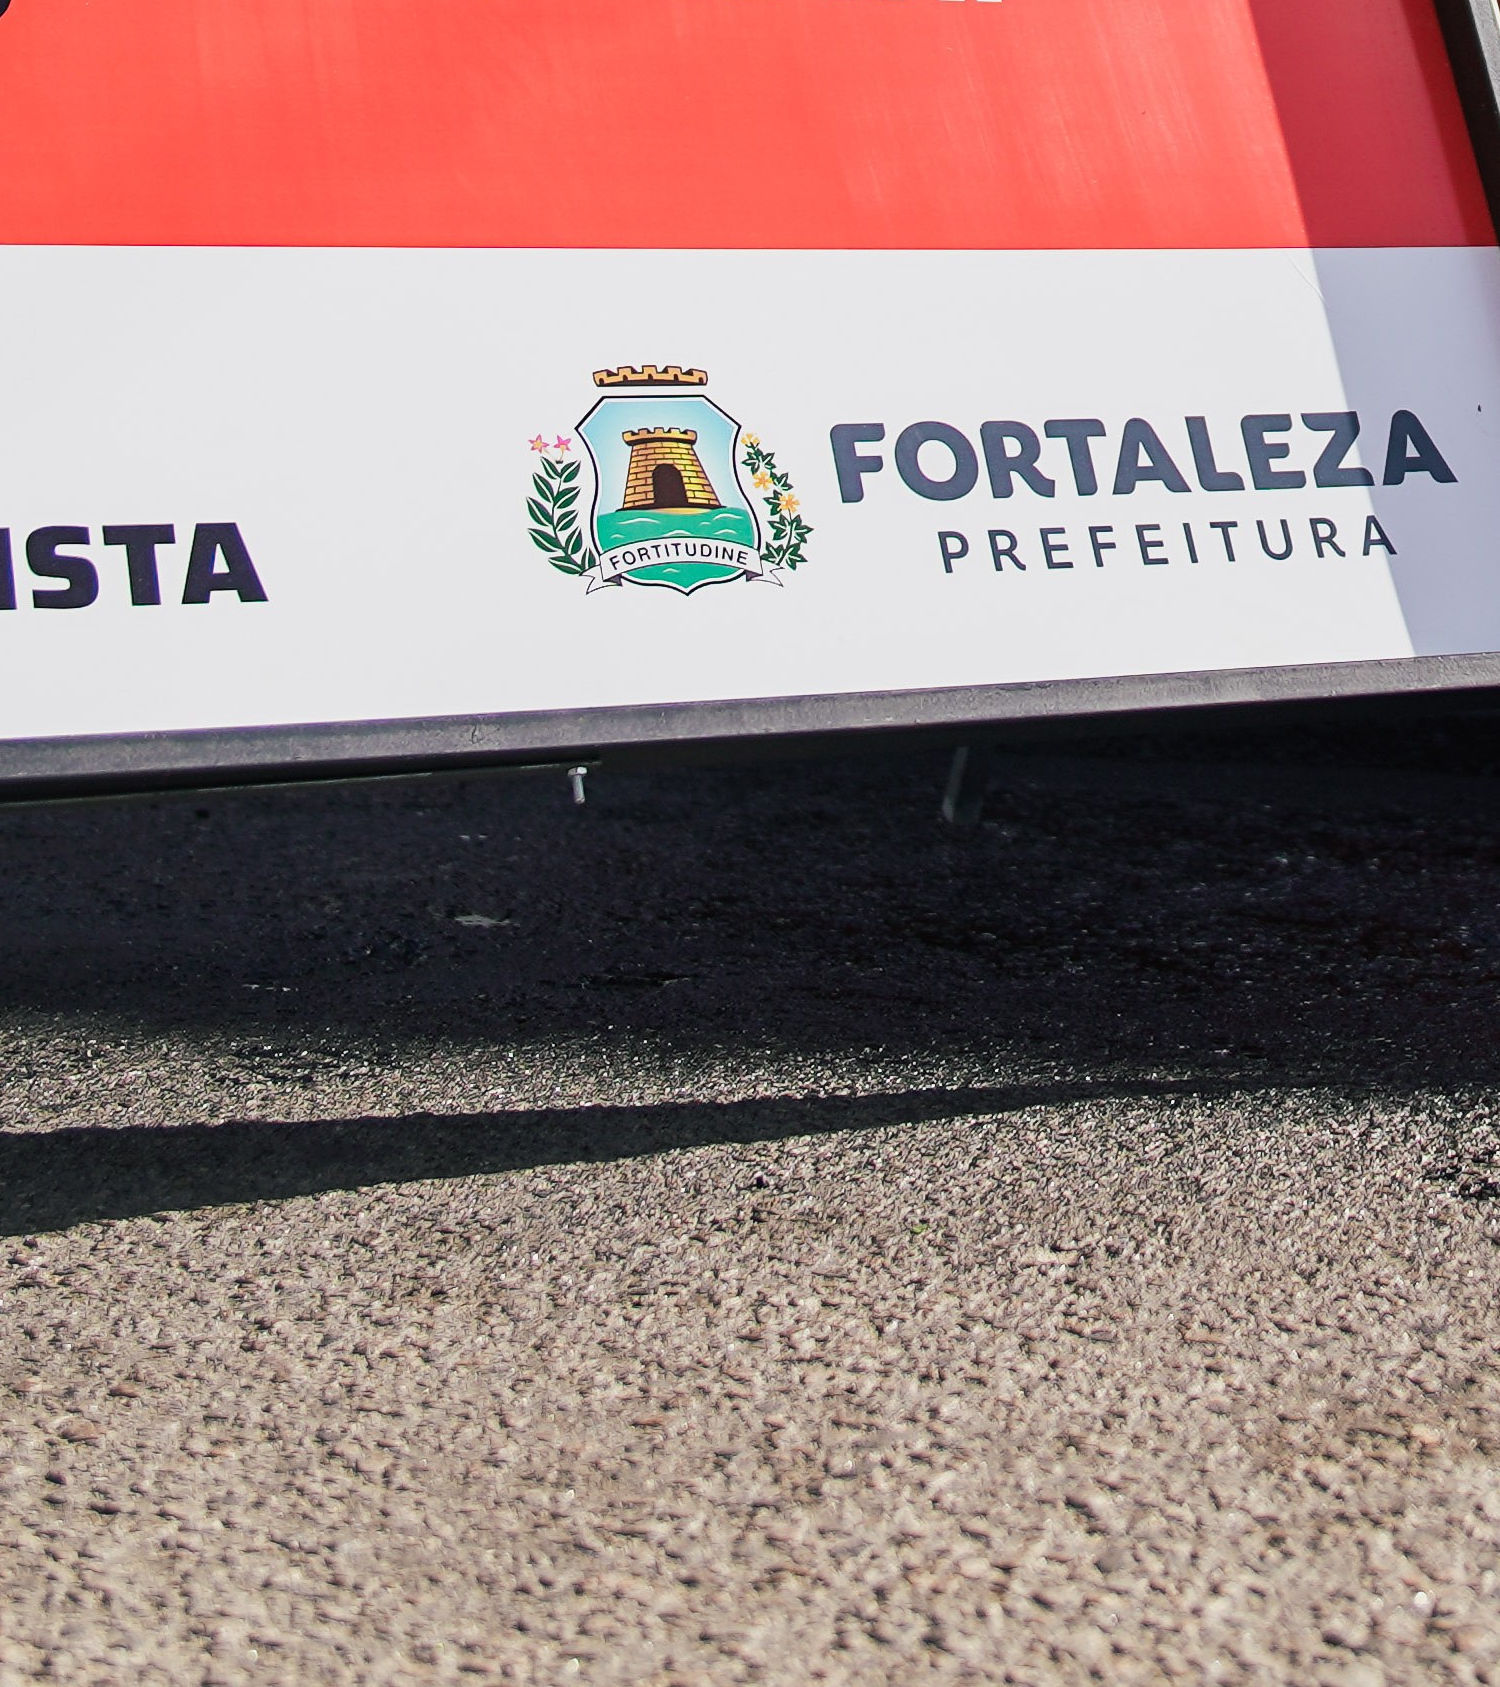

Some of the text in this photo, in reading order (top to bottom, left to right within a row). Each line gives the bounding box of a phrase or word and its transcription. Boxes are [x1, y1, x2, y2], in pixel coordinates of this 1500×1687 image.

[829, 409, 1459, 504] FORTALEZA
[608, 542, 749, 571] FORTITUDINE
[937, 514, 1398, 574] PREFEITURA
